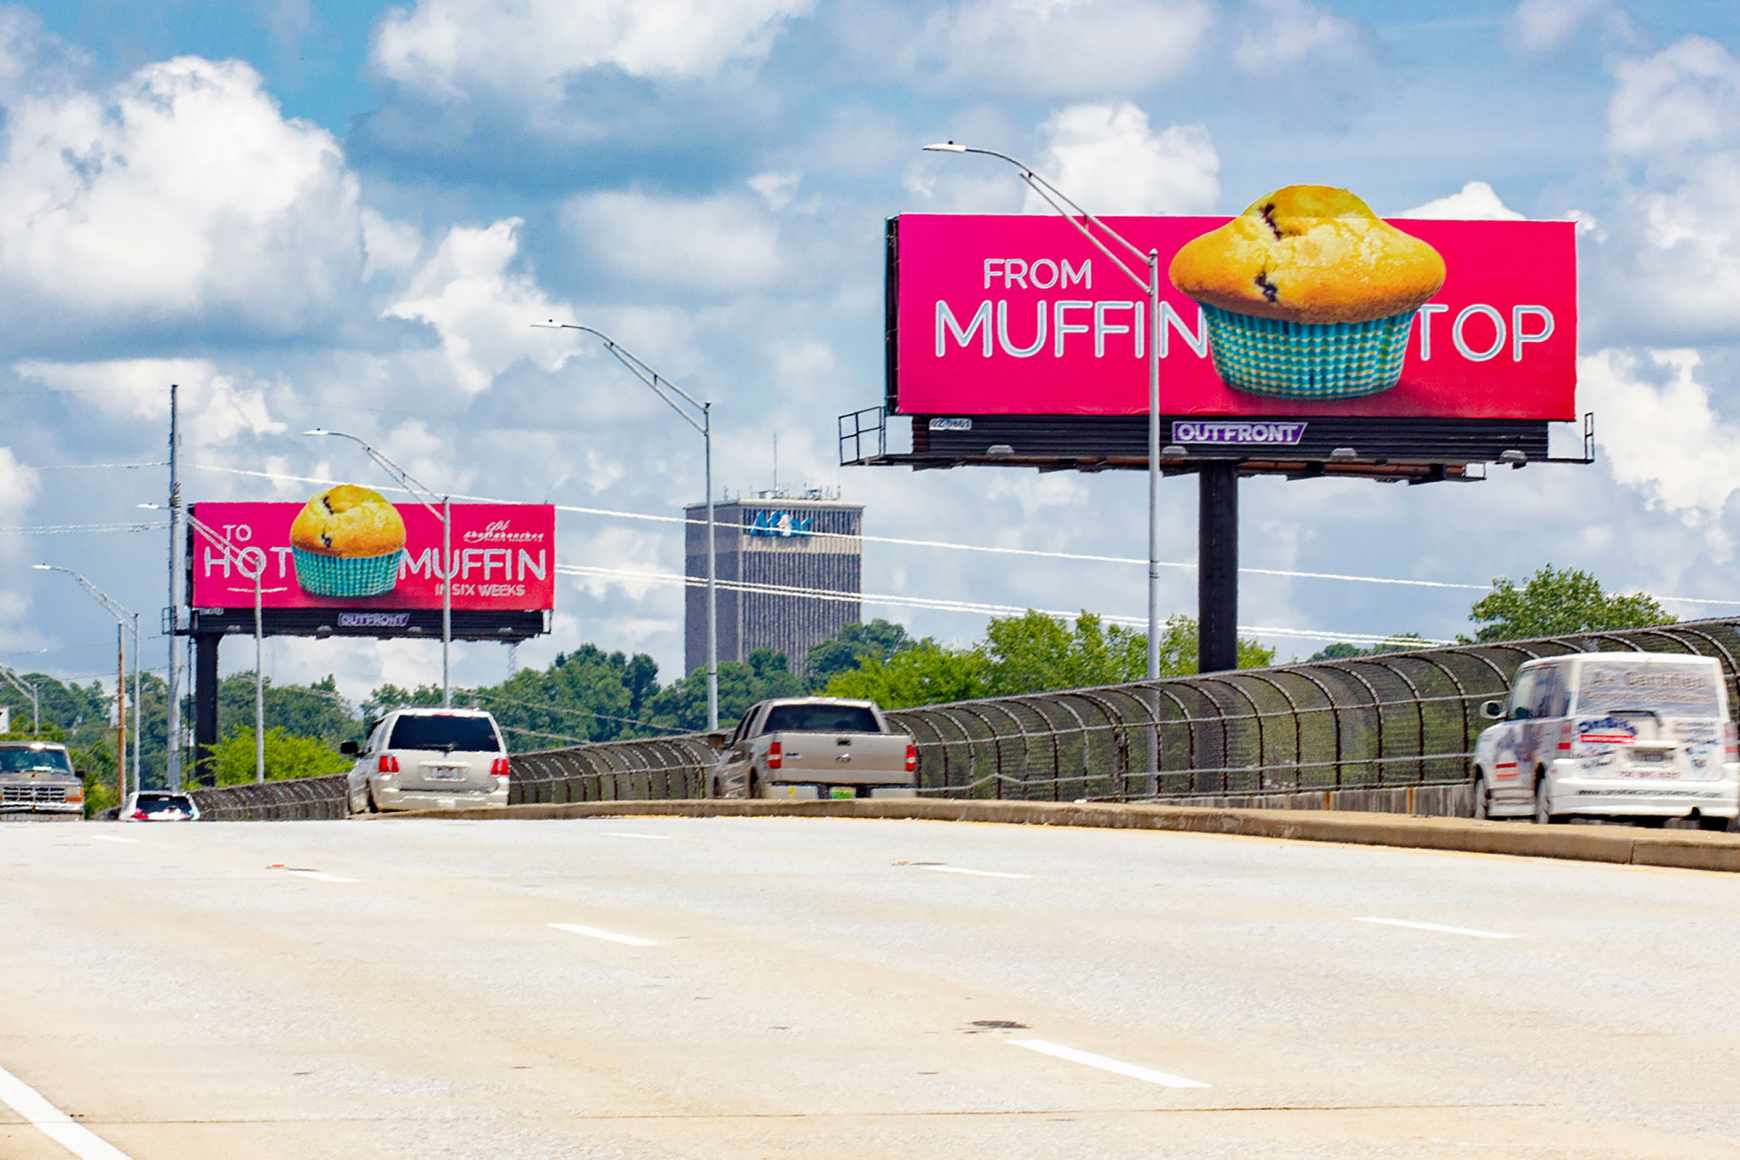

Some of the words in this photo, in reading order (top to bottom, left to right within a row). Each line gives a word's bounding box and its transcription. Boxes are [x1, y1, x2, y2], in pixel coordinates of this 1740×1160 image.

[983, 258, 1092, 290] FROM
[935, 299, 1208, 359] MUFFIN
[1416, 303, 1556, 362] TOP
[1178, 424, 1299, 441] OUTFRONT
[222, 524, 252, 543] TO
[204, 546, 293, 578] HOT
[399, 547, 546, 581] MUFFIN
[452, 583, 476, 596] SIX
[478, 584, 526, 597] WEEKS
